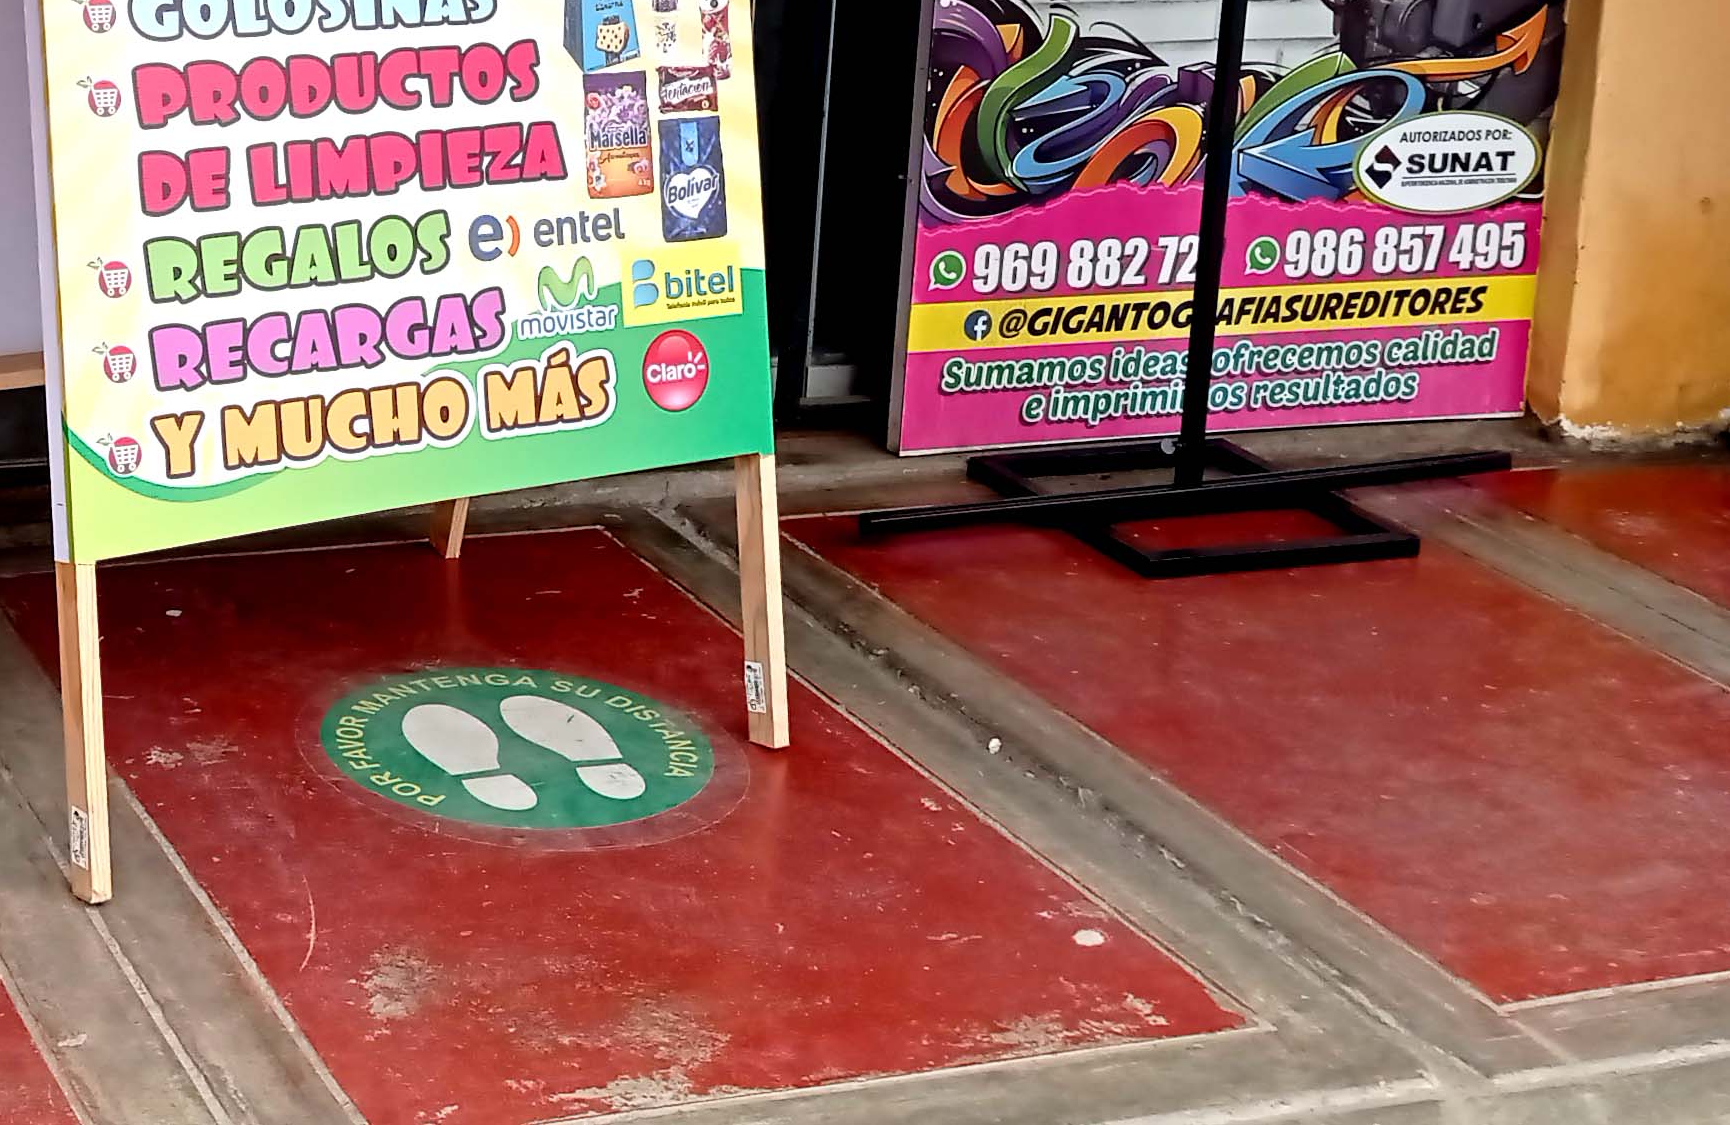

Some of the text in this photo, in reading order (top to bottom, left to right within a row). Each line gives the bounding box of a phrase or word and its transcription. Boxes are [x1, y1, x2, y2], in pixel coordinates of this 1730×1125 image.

[132, 40, 541, 129] PRODUCTOS
[590, 127, 647, 150] Marsella
[1400, 128, 1513, 143] AUTORIZADOS POR:
[1406, 150, 1516, 174] SUNAT
[138, 120, 568, 217] DE LIMPIEZA
[669, 175, 718, 203] Bolívar
[533, 207, 626, 248] entel
[1284, 221, 1526, 278] 986 857 495
[144, 209, 451, 305] REGALOS
[665, 265, 735, 300] bitel
[973, 235, 1201, 293] 969 882 72
[148, 286, 506, 392] RECARGAS
[521, 305, 618, 338] movistar
[999, 285, 1488, 339] @GIGANTOGAFIASUREDITORES
[646, 363, 698, 384] Claro
[943, 357, 1106, 392] Sumamos
[1212, 340, 1383, 375] ofrecemos
[1386, 328, 1499, 362] calidad
[152, 347, 611, 479] Y MUCHO MÁS
[1023, 370, 1418, 423] e imprimios resultados
[335, 672, 698, 807] POR FAVOR MANTENGA SU DISTANCIA
